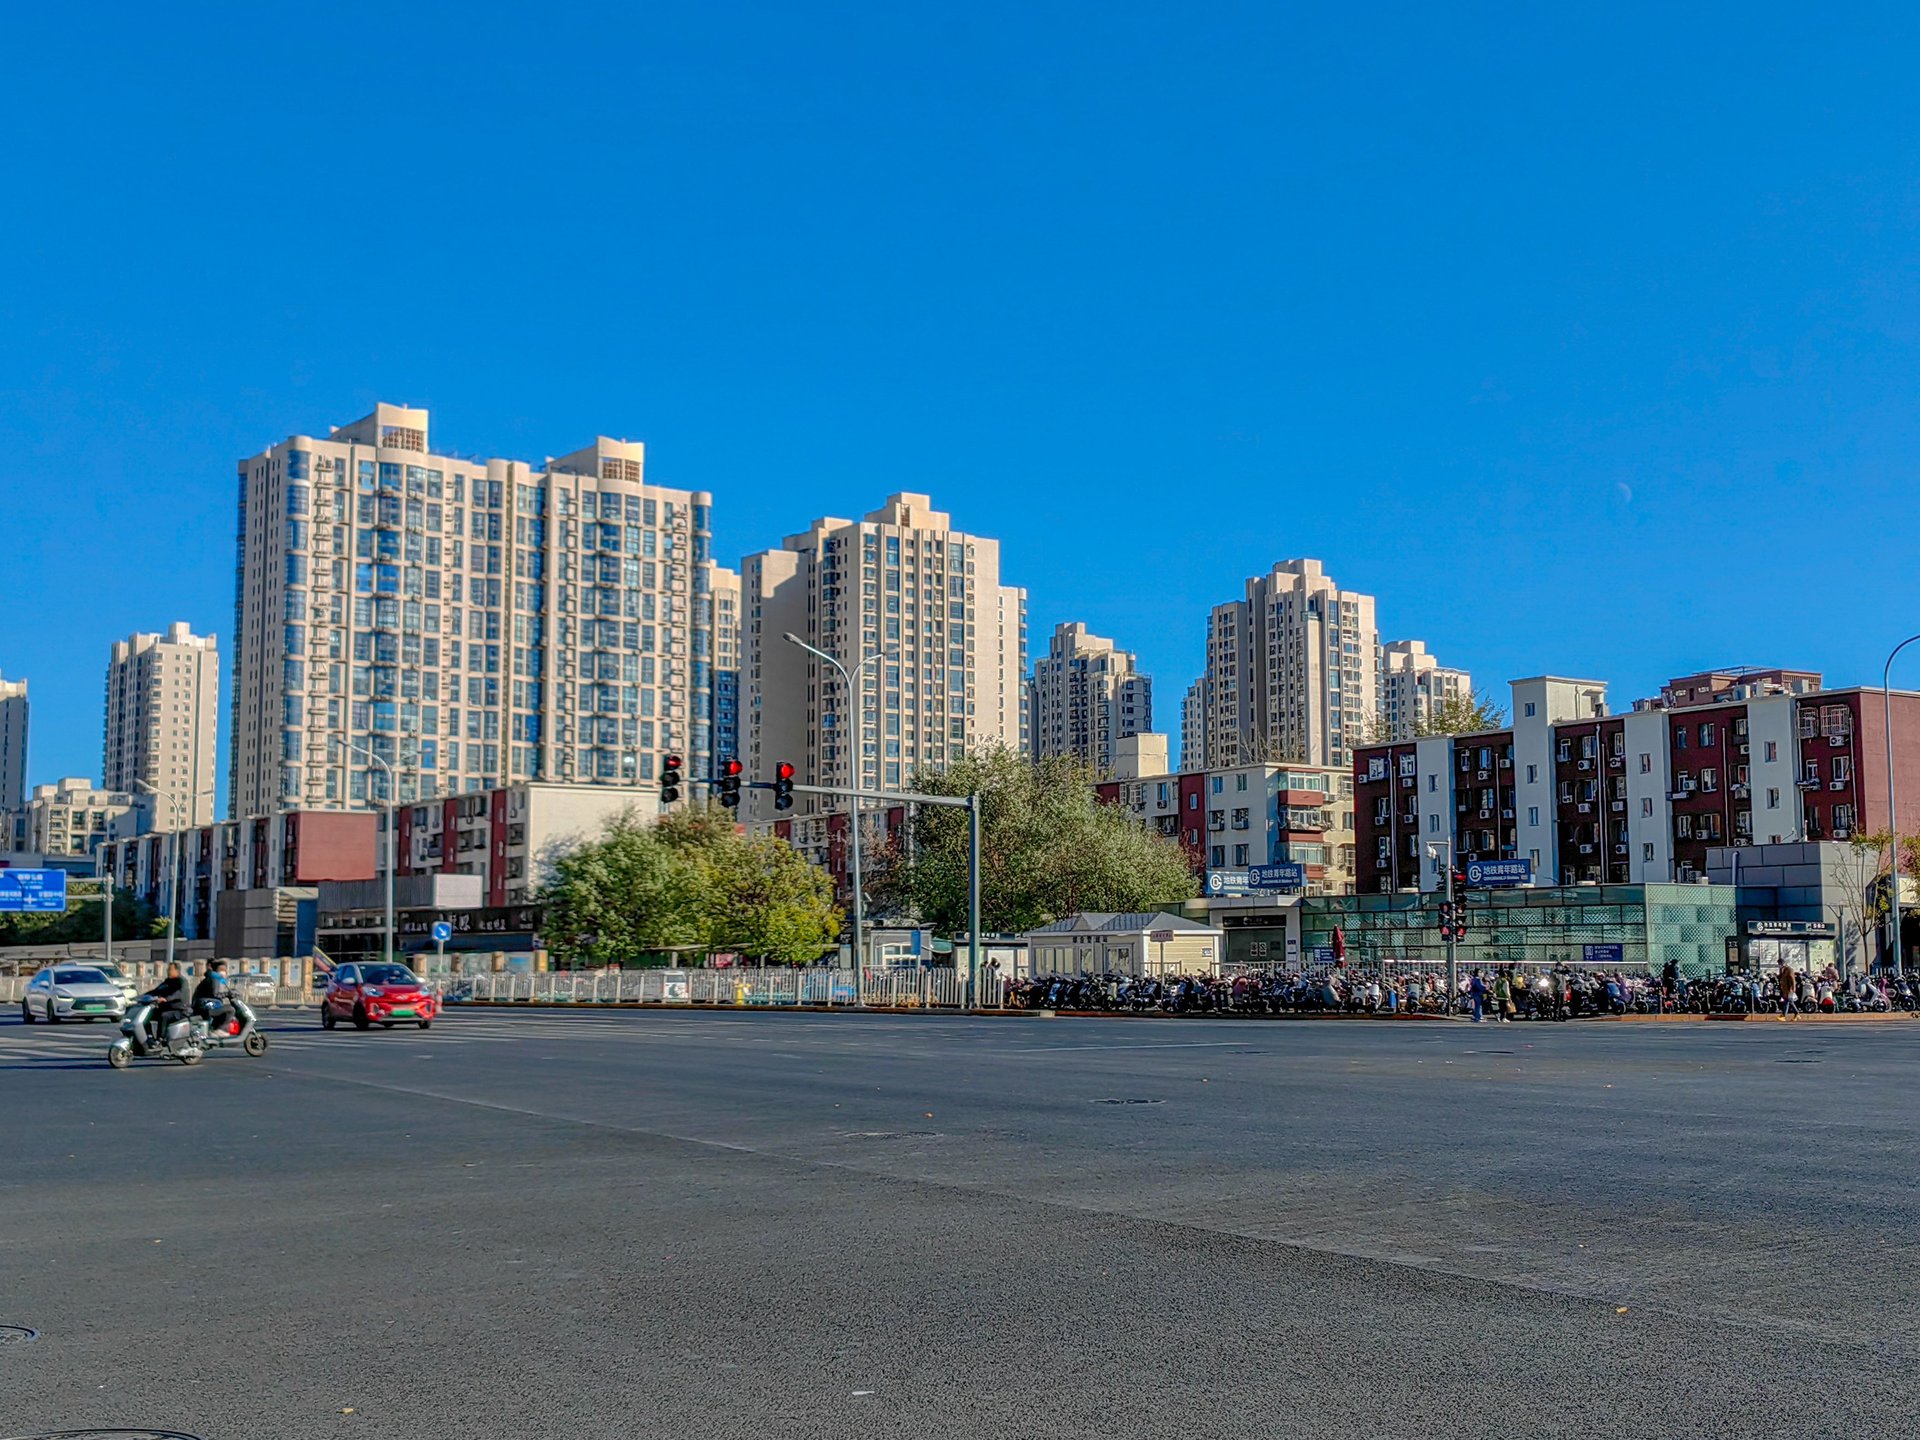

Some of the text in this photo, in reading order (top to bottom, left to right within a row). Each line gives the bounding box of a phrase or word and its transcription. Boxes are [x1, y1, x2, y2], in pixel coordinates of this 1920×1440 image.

[1261, 868, 1297, 878] 地铁青年路站
[1483, 864, 1525, 875] 地铁青年路站
